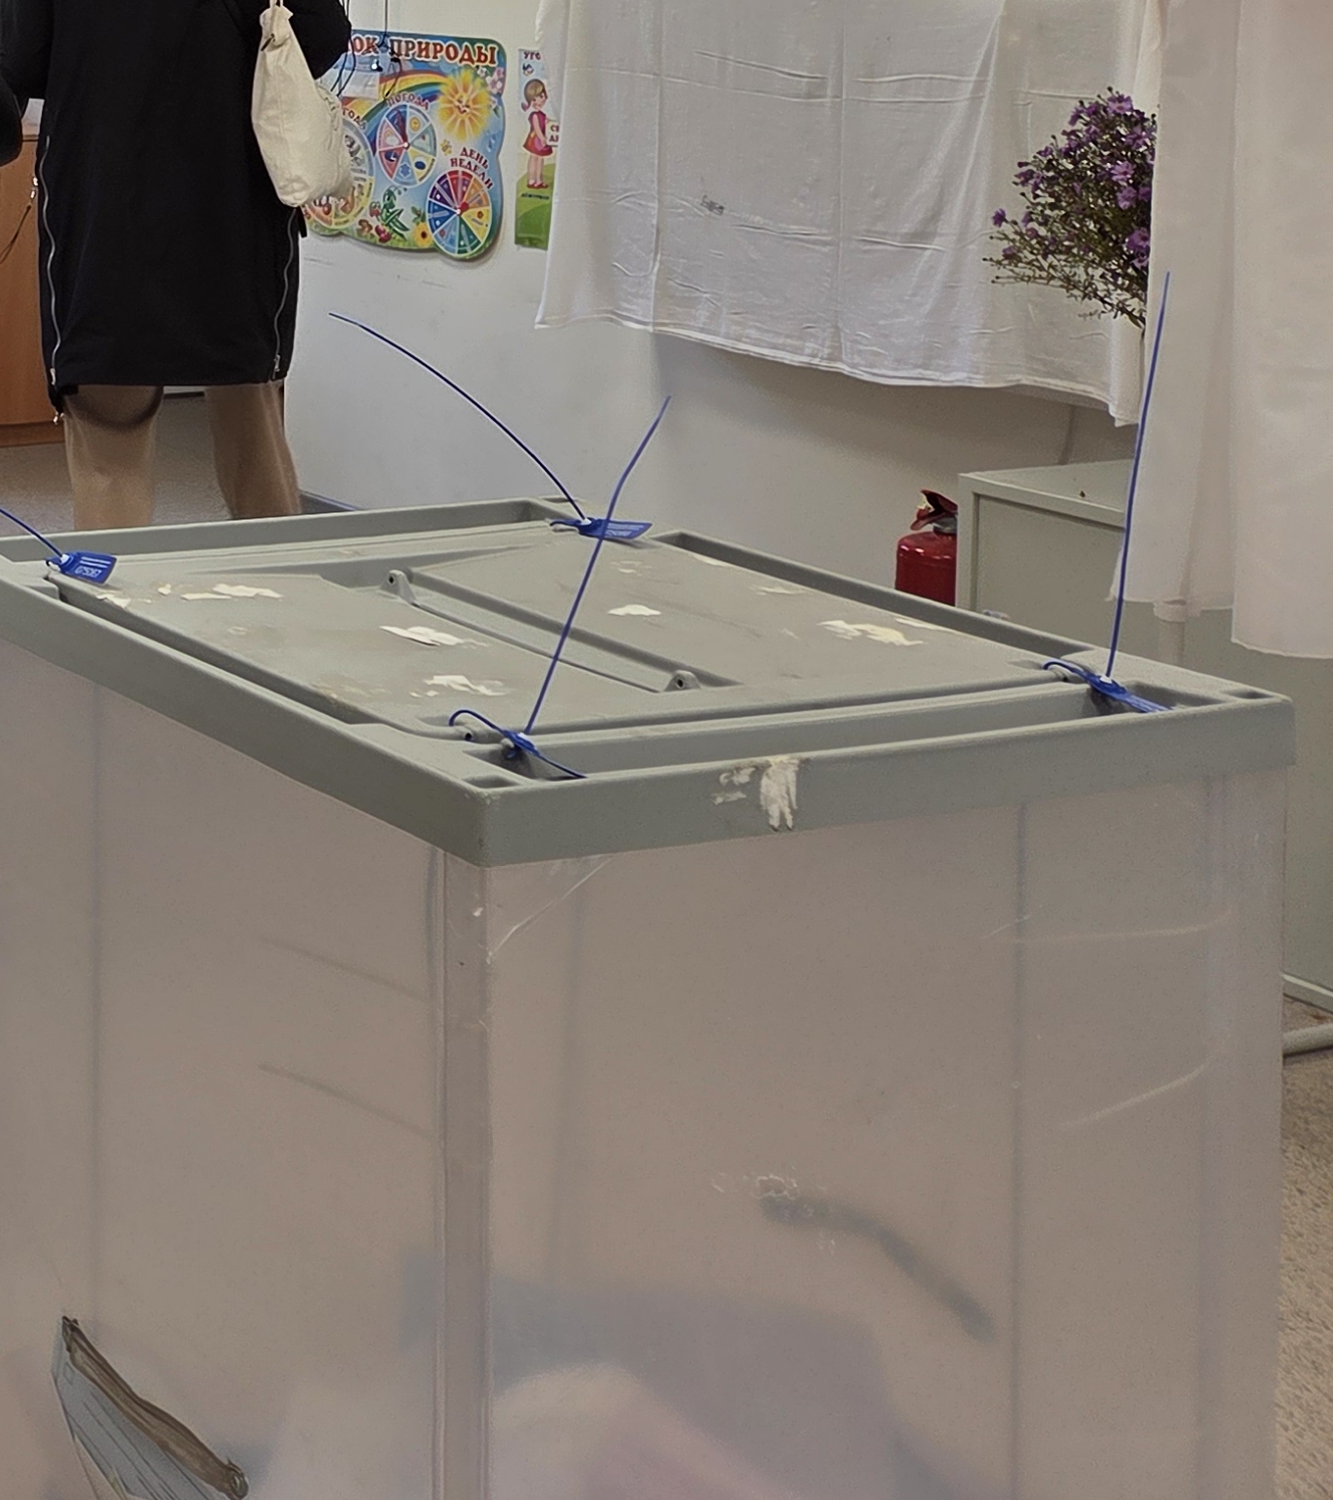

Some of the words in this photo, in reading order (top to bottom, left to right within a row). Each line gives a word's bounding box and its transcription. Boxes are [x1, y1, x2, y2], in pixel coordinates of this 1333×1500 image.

[352, 36, 379, 55] ОК
[389, 38, 498, 66] ПРИРОДЫ
[387, 92, 431, 111] ПОГОДА
[459, 146, 489, 169] ДЕНЬ
